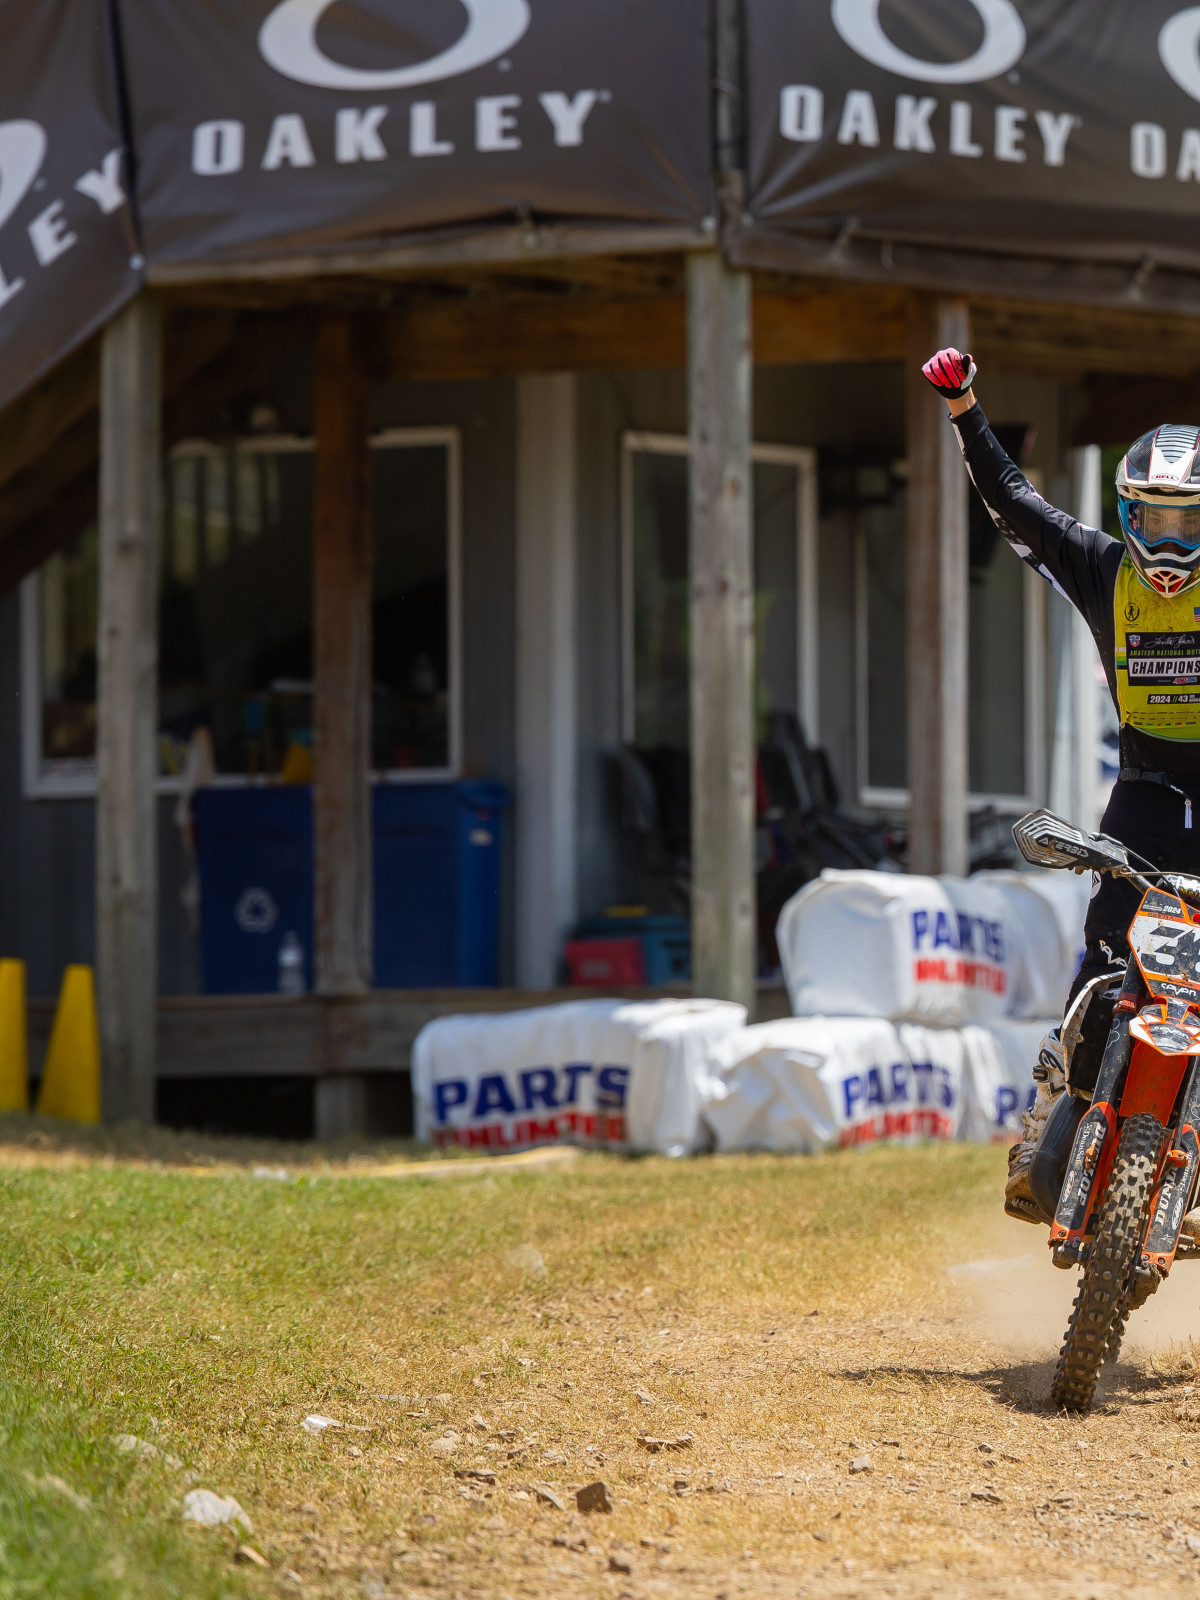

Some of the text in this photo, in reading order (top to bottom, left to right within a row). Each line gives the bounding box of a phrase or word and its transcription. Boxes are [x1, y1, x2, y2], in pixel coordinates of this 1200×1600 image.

[192, 90, 599, 176] OAKLEY
[780, 84, 1077, 168] OAKLEY
[1150, 695, 1171, 704] 2024
[1178, 695, 1189, 703] 43
[911, 910, 1004, 962] PARTS
[1163, 905, 1181, 915] 2024
[432, 1062, 630, 1122] PARTS
[842, 1063, 954, 1119] PARTS
